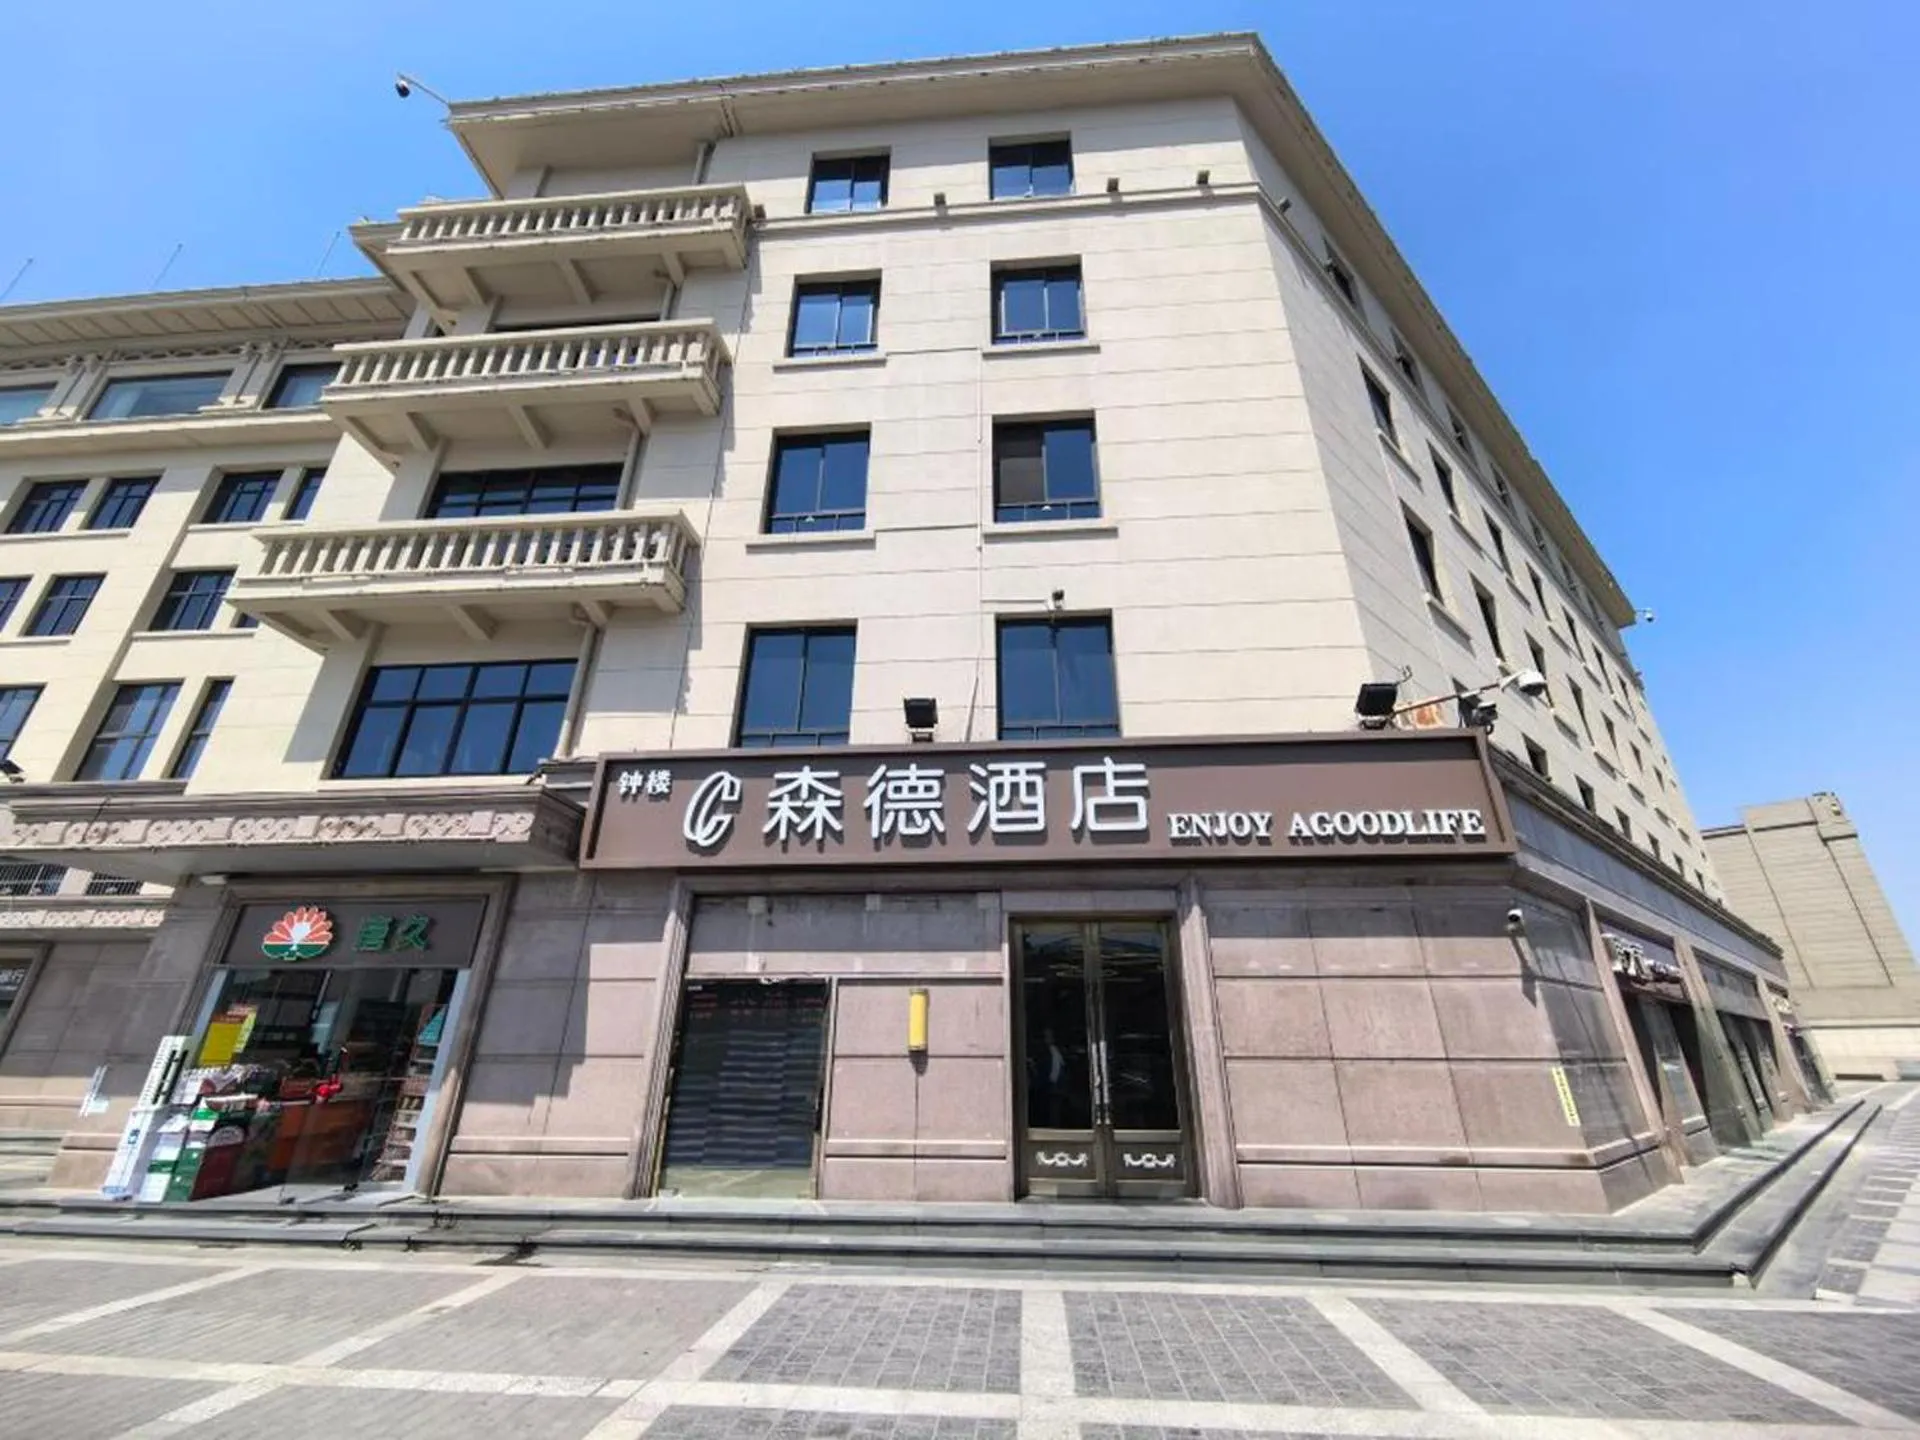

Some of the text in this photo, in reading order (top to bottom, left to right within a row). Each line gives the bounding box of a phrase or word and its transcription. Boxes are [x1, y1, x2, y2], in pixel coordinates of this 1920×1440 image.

[618, 769, 671, 795] 钟楼
[763, 757, 1150, 840] 森德酒店
[1168, 808, 1487, 838] ENJOY AGOODLIFE
